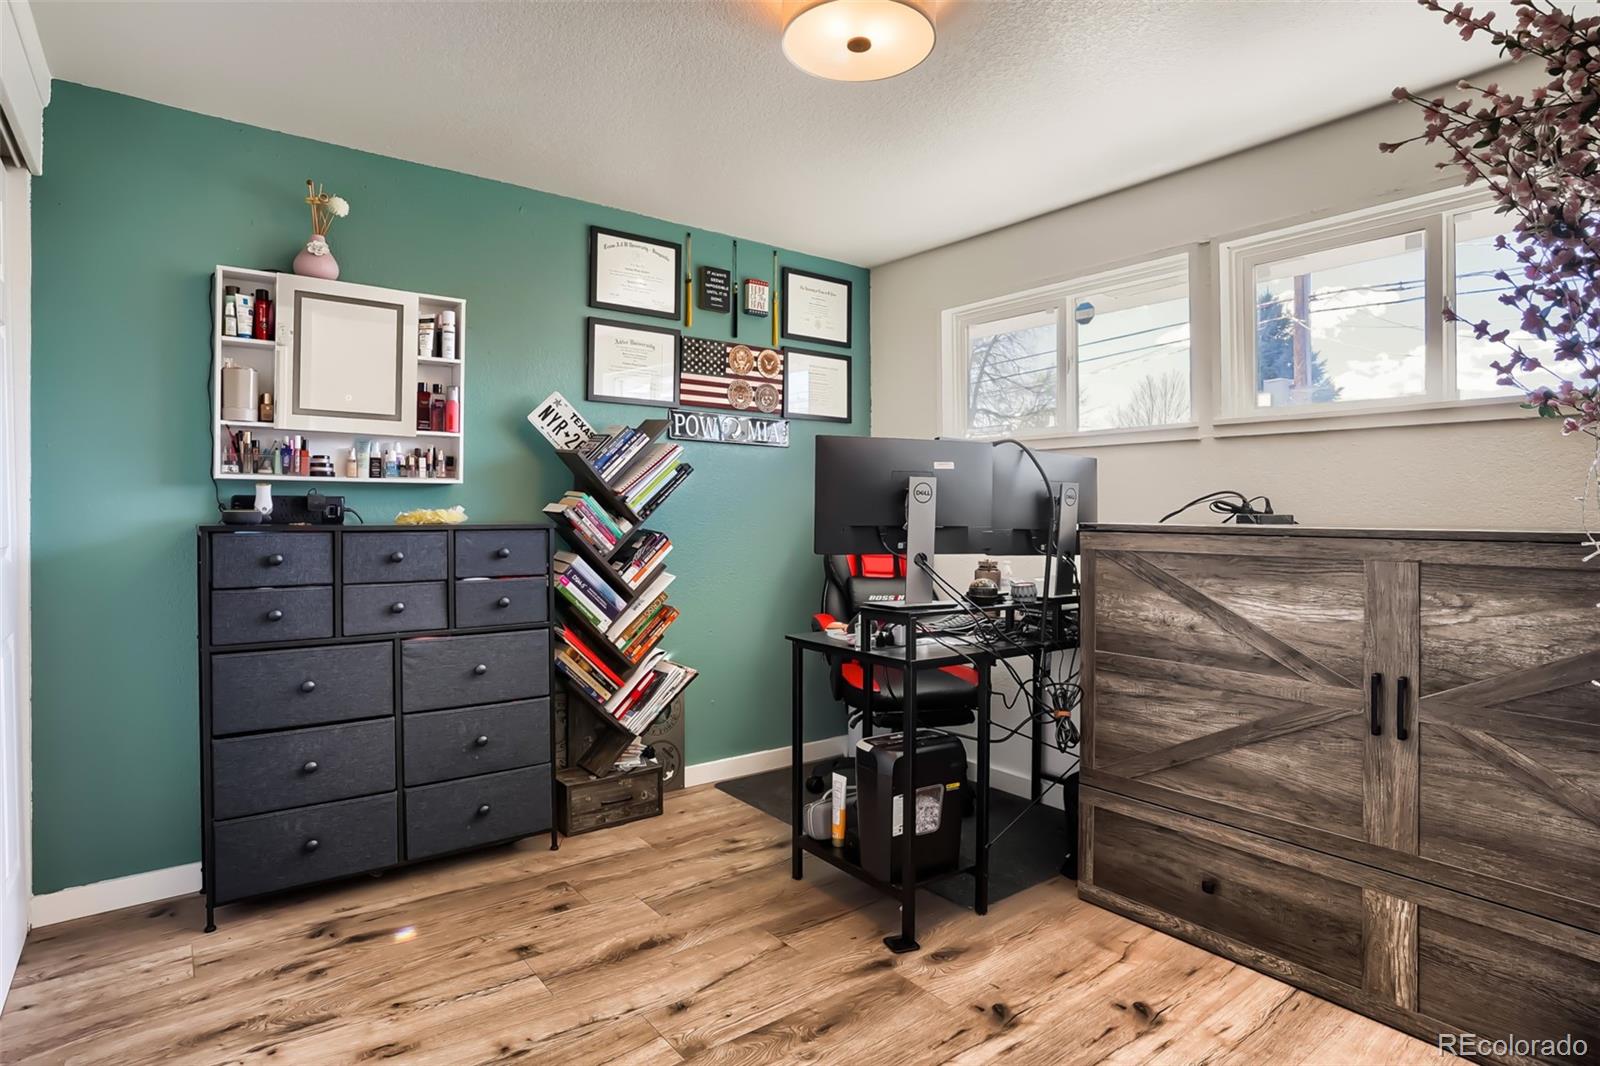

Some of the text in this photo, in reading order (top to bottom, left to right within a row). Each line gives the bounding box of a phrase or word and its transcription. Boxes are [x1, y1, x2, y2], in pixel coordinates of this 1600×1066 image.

[538, 405, 568, 436] NYR
[570, 412, 595, 439] TEXAS
[673, 413, 780, 442] POW MIA
